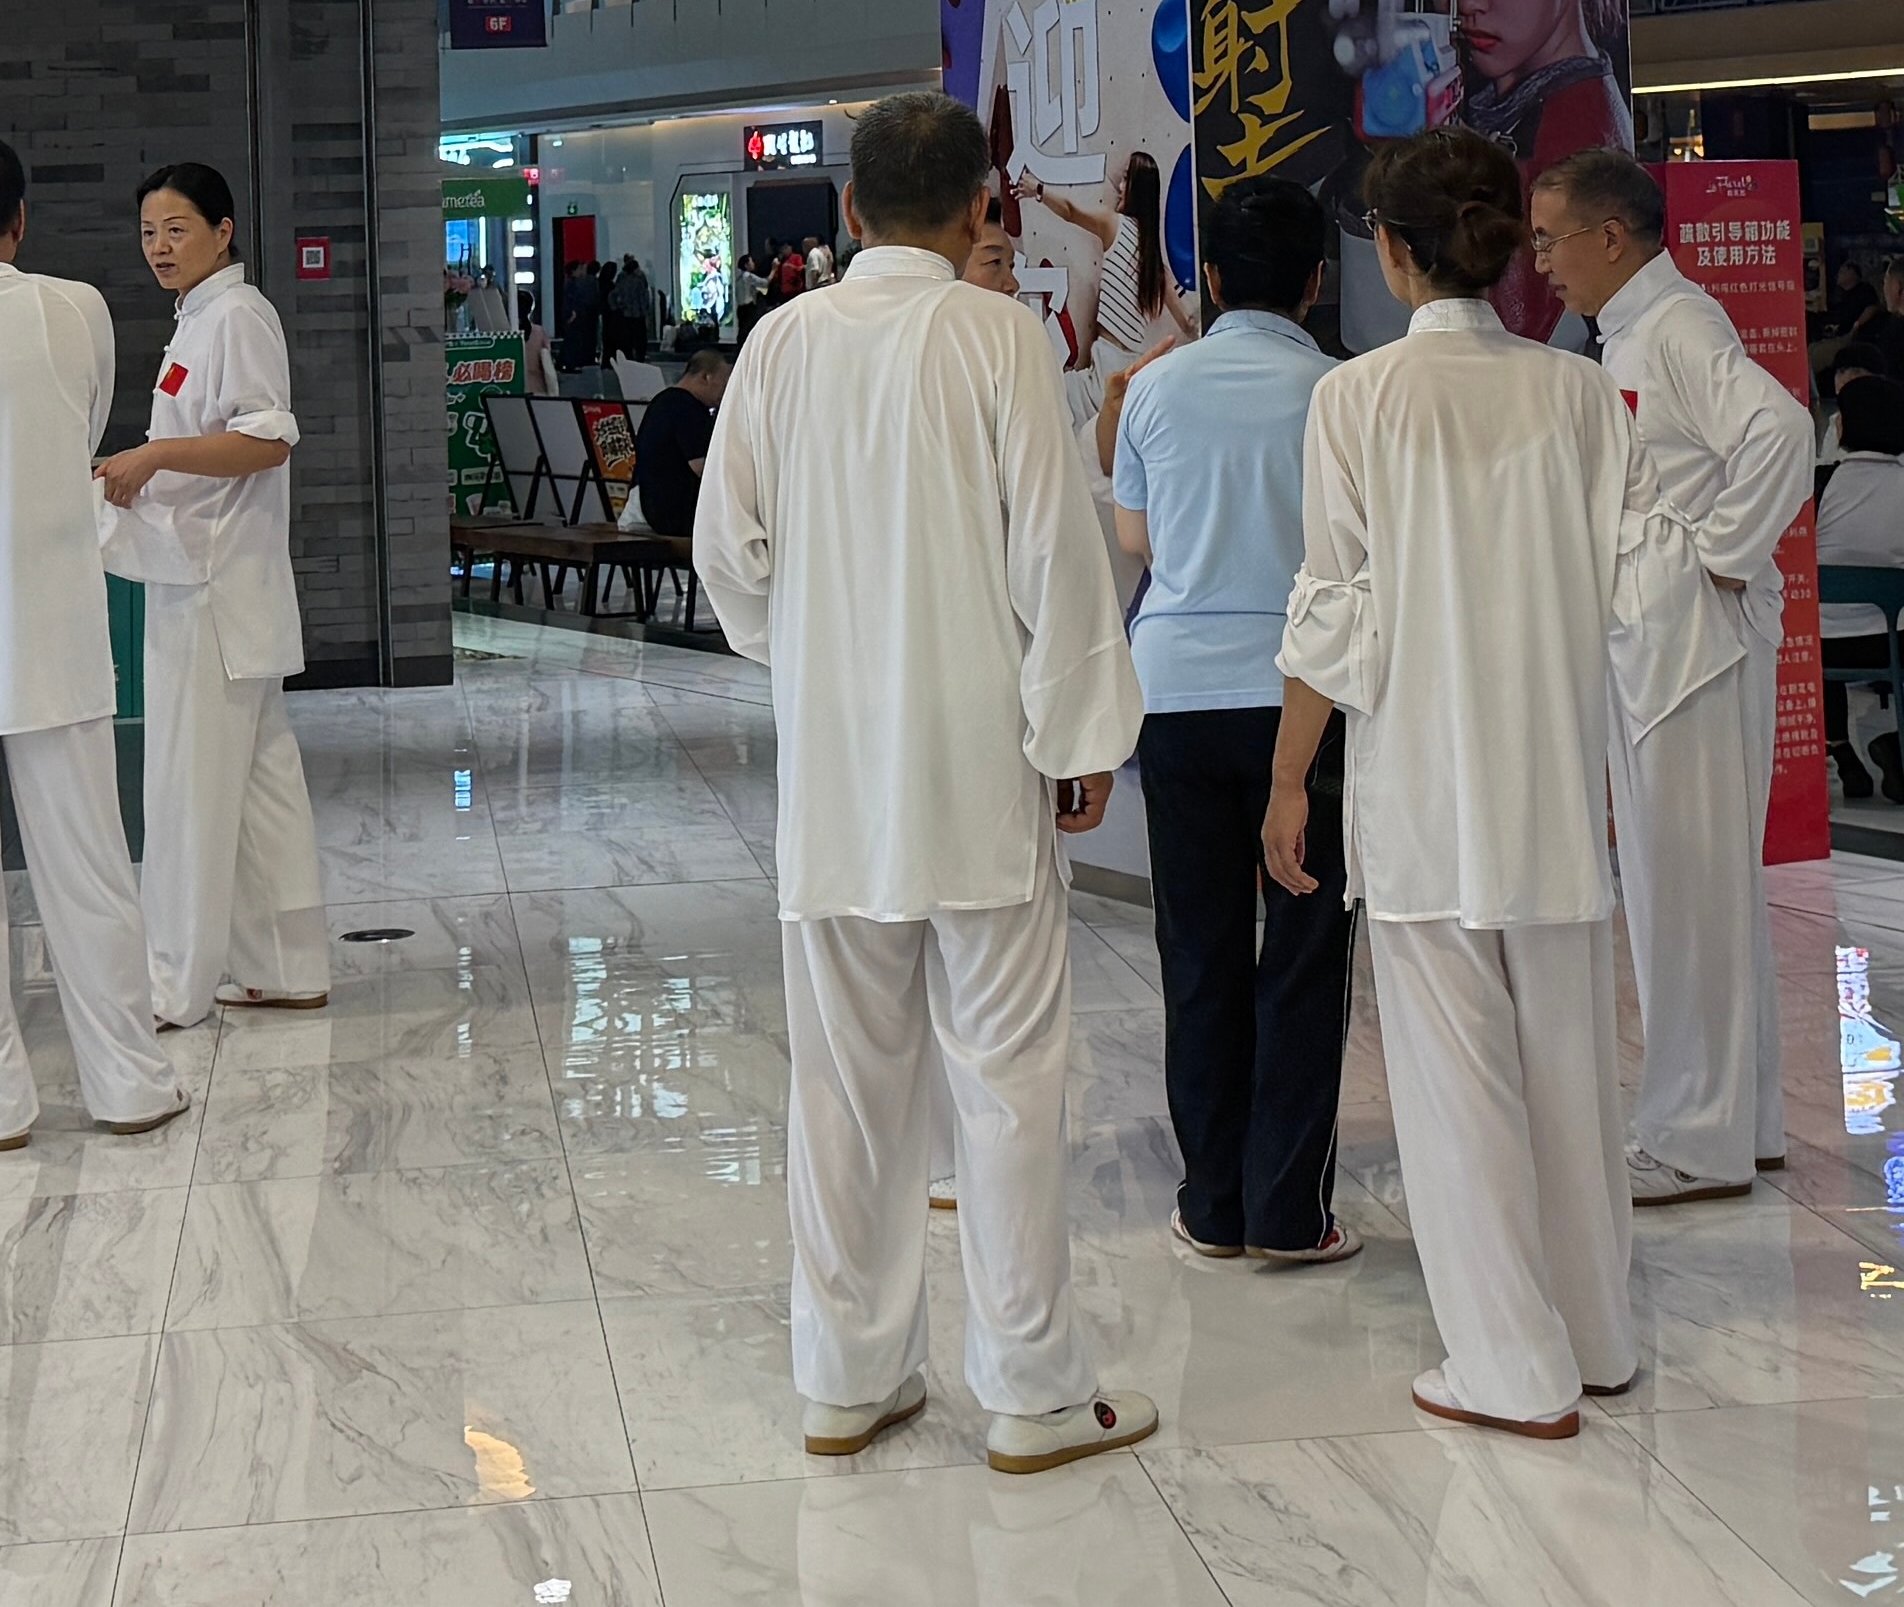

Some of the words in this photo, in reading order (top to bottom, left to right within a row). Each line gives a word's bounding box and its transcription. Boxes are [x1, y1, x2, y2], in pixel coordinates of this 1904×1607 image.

[1679, 219, 1791, 244] 疏散引导箱功能
[1697, 244, 1777, 267] 及使用方法
[447, 358, 516, 385] 必喝榜
